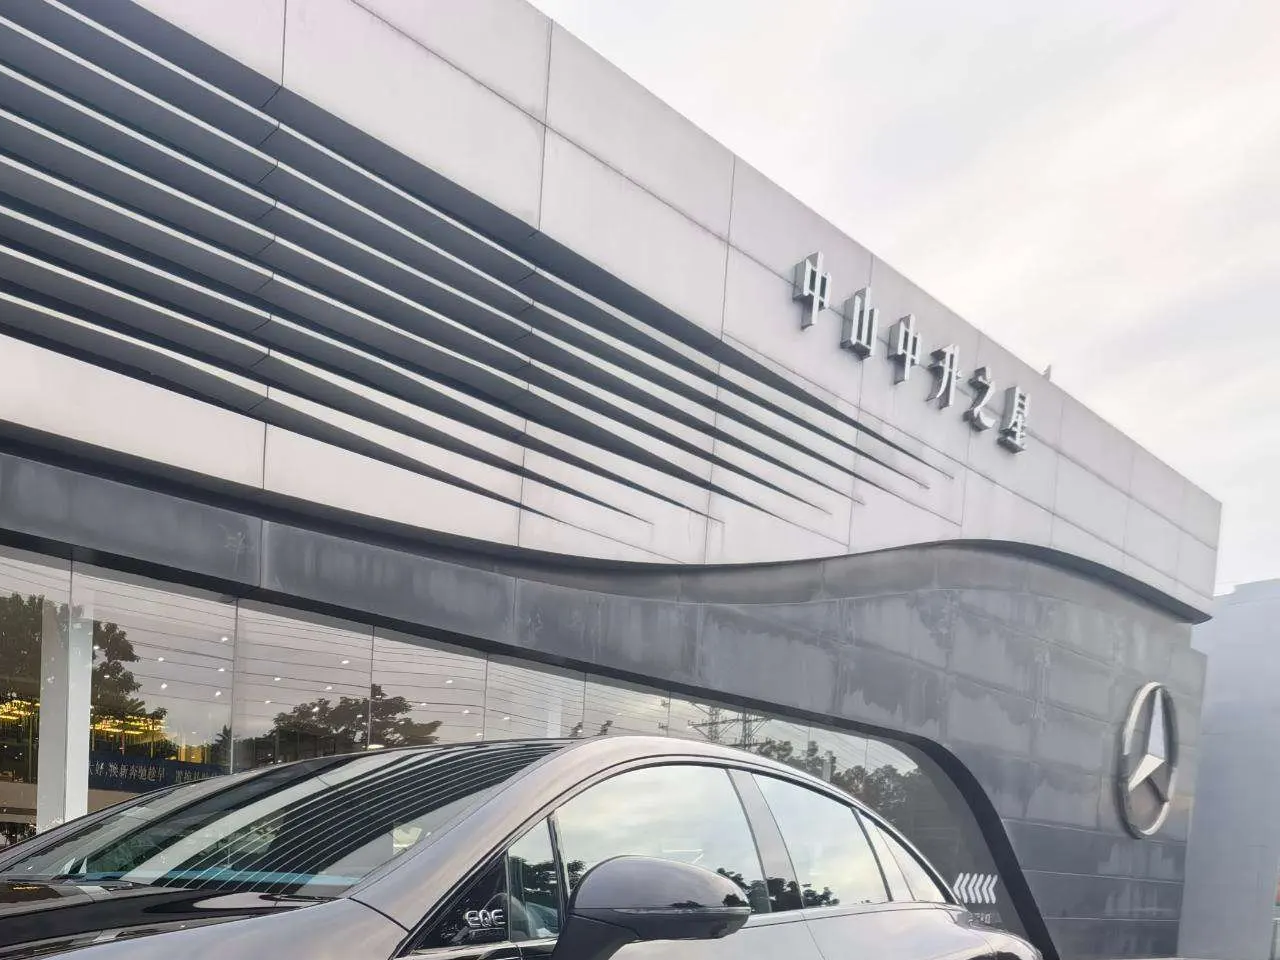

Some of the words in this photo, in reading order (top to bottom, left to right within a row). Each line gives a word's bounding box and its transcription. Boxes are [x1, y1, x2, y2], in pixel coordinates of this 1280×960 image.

[792, 251, 1030, 454] 中山中升之星
[466, 909, 506, 927] EQE
